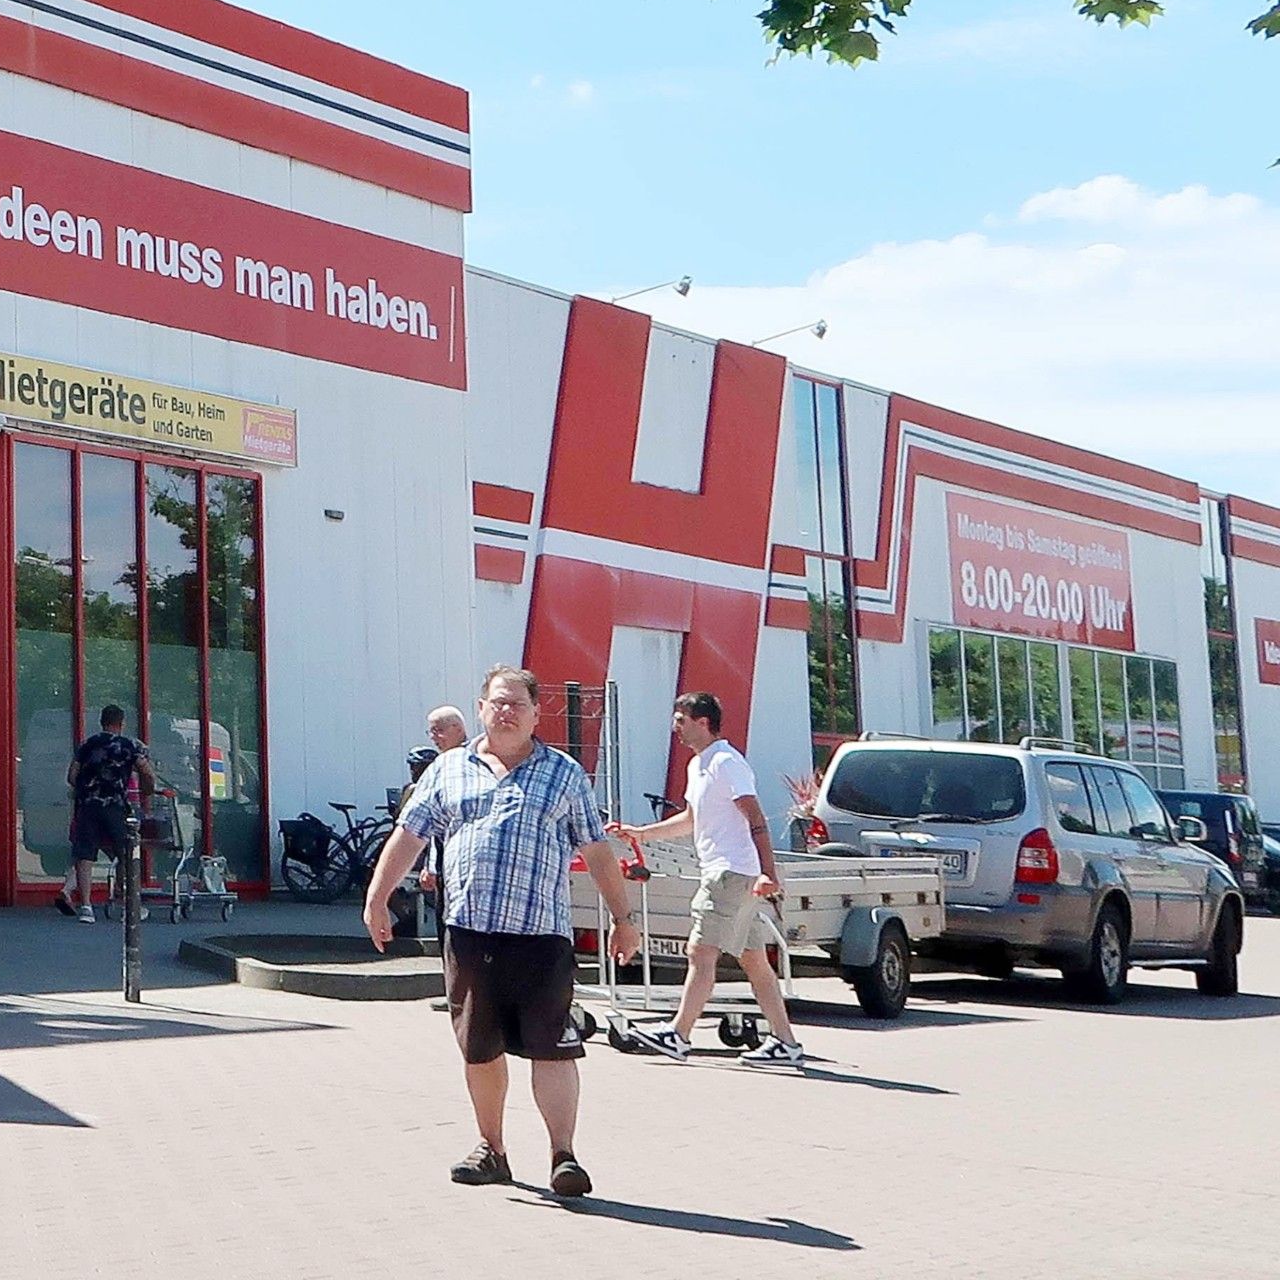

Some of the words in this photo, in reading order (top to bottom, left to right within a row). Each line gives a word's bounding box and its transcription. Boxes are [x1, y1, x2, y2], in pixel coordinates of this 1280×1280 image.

[116, 225, 224, 289] muss
[235, 256, 315, 312] man
[326, 268, 438, 340] haben.
[152, 392, 169, 410] für
[171, 396, 195, 418] Bau,
[197, 400, 226, 422] Heim
[152, 420, 174, 438] und
[176, 422, 213, 444] Garten
[957, 512, 1004, 551] Montag
[1005, 524, 1026, 551] bis
[1027, 528, 1077, 566] Samstag
[960, 560, 1084, 626] 8.00-20.00
[1089, 584, 1127, 632] Uhr
